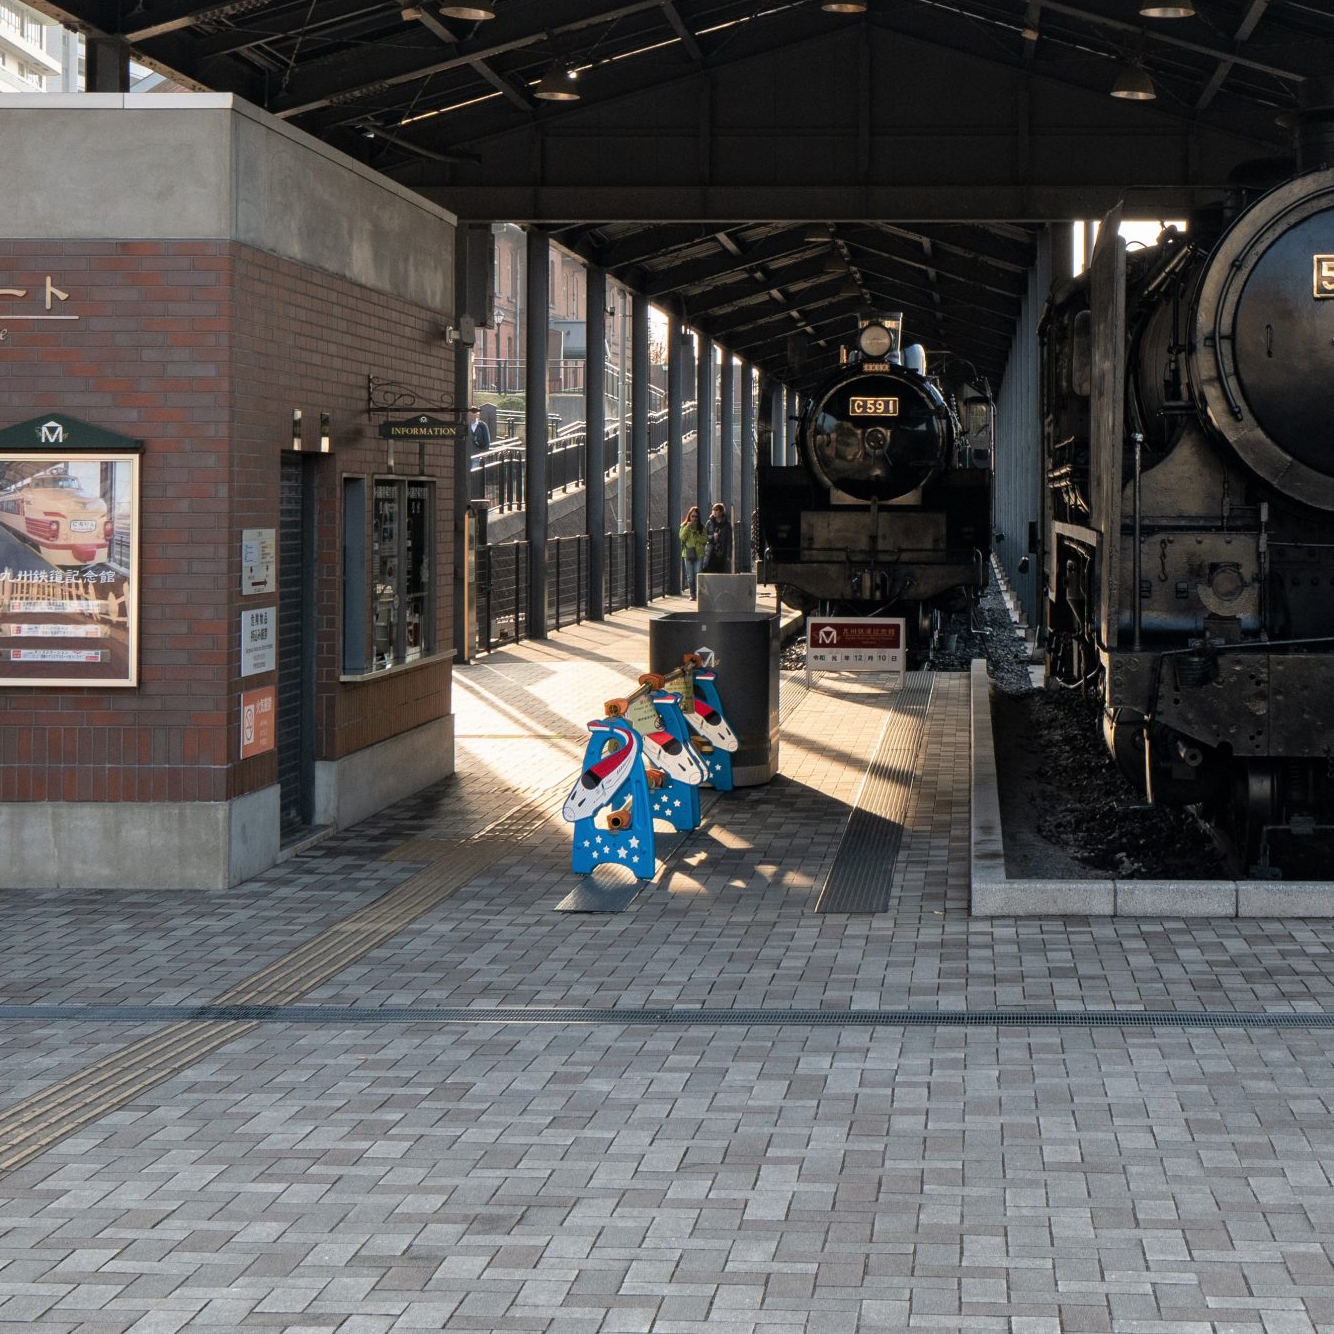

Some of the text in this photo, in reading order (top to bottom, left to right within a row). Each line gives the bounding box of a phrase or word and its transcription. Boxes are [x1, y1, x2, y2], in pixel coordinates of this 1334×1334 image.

[391, 427, 457, 436] INFORMATION
[0, 569, 116, 584] 九州鉄道記念館
